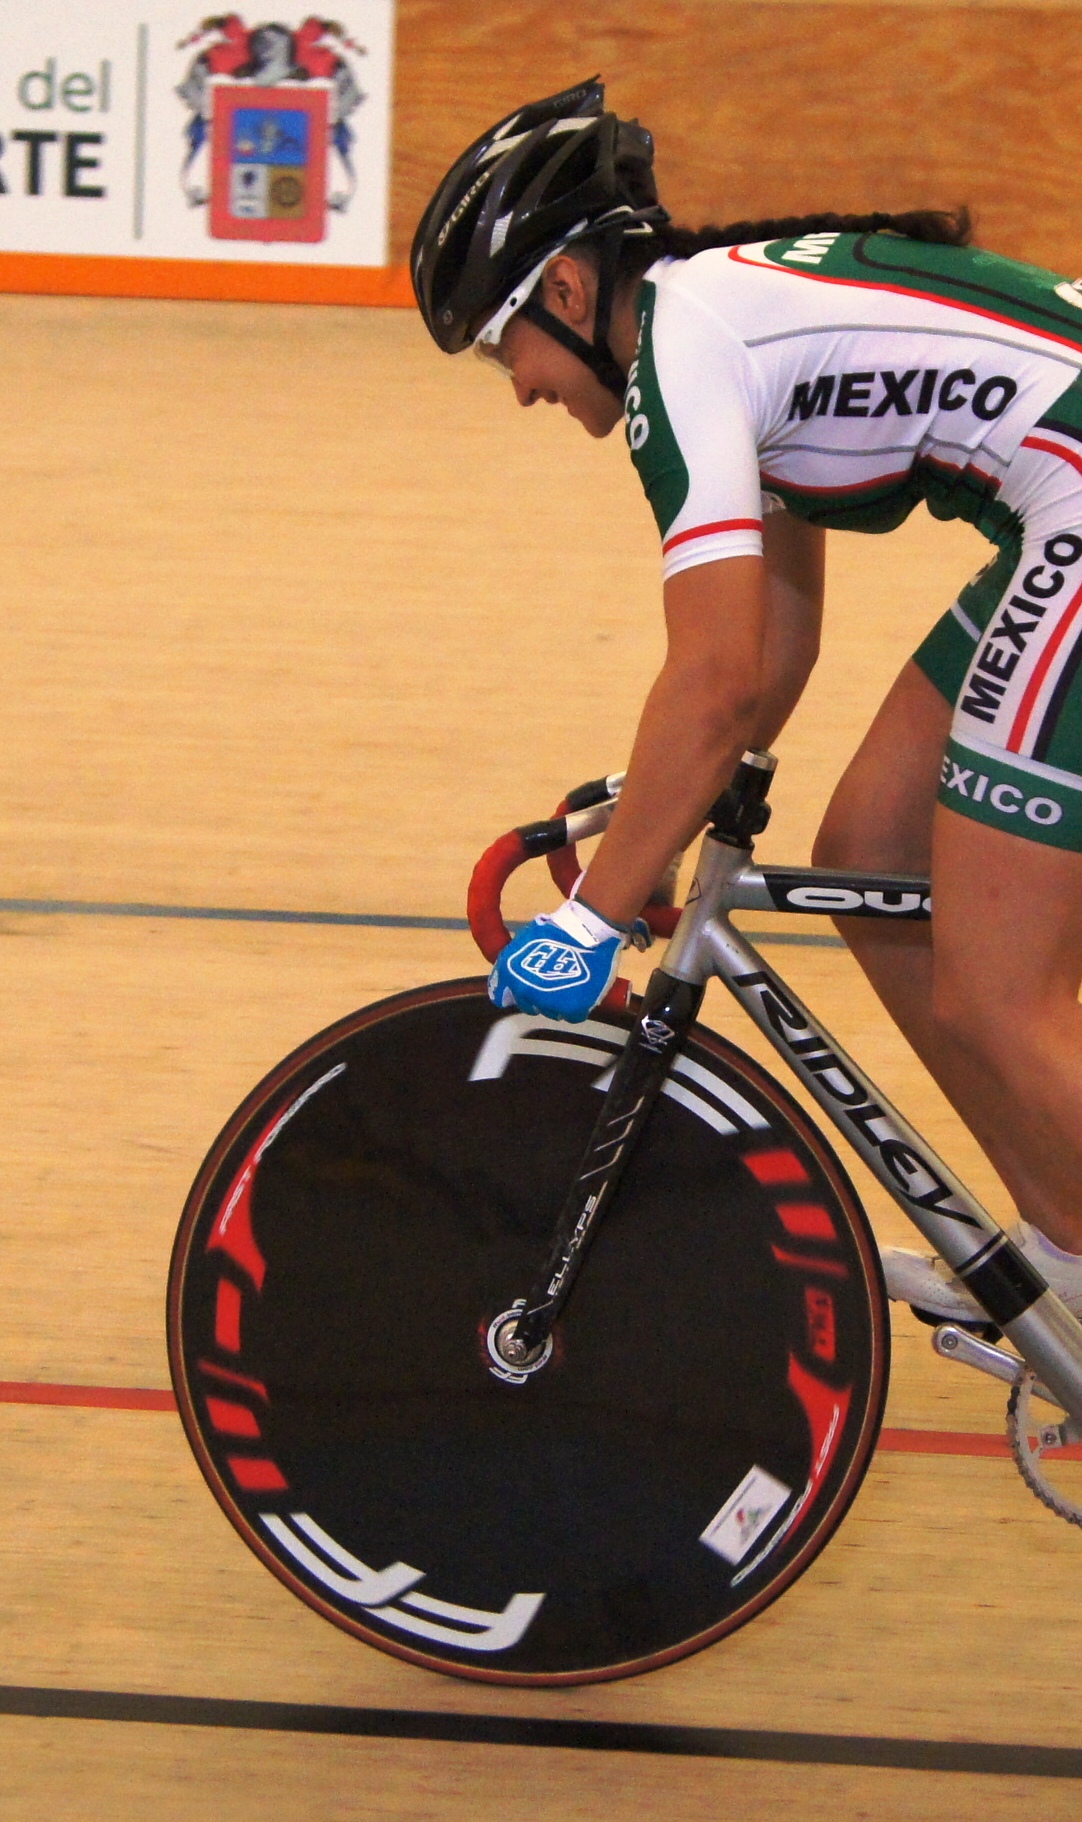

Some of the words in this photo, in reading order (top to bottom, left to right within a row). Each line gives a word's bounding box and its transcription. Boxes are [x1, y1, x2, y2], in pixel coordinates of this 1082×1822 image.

[17, 56, 111, 113] del
[0, 130, 106, 199] TE
[788, 367, 1017, 421] MEXICO
[732, 971, 984, 1230] RIDLEY
